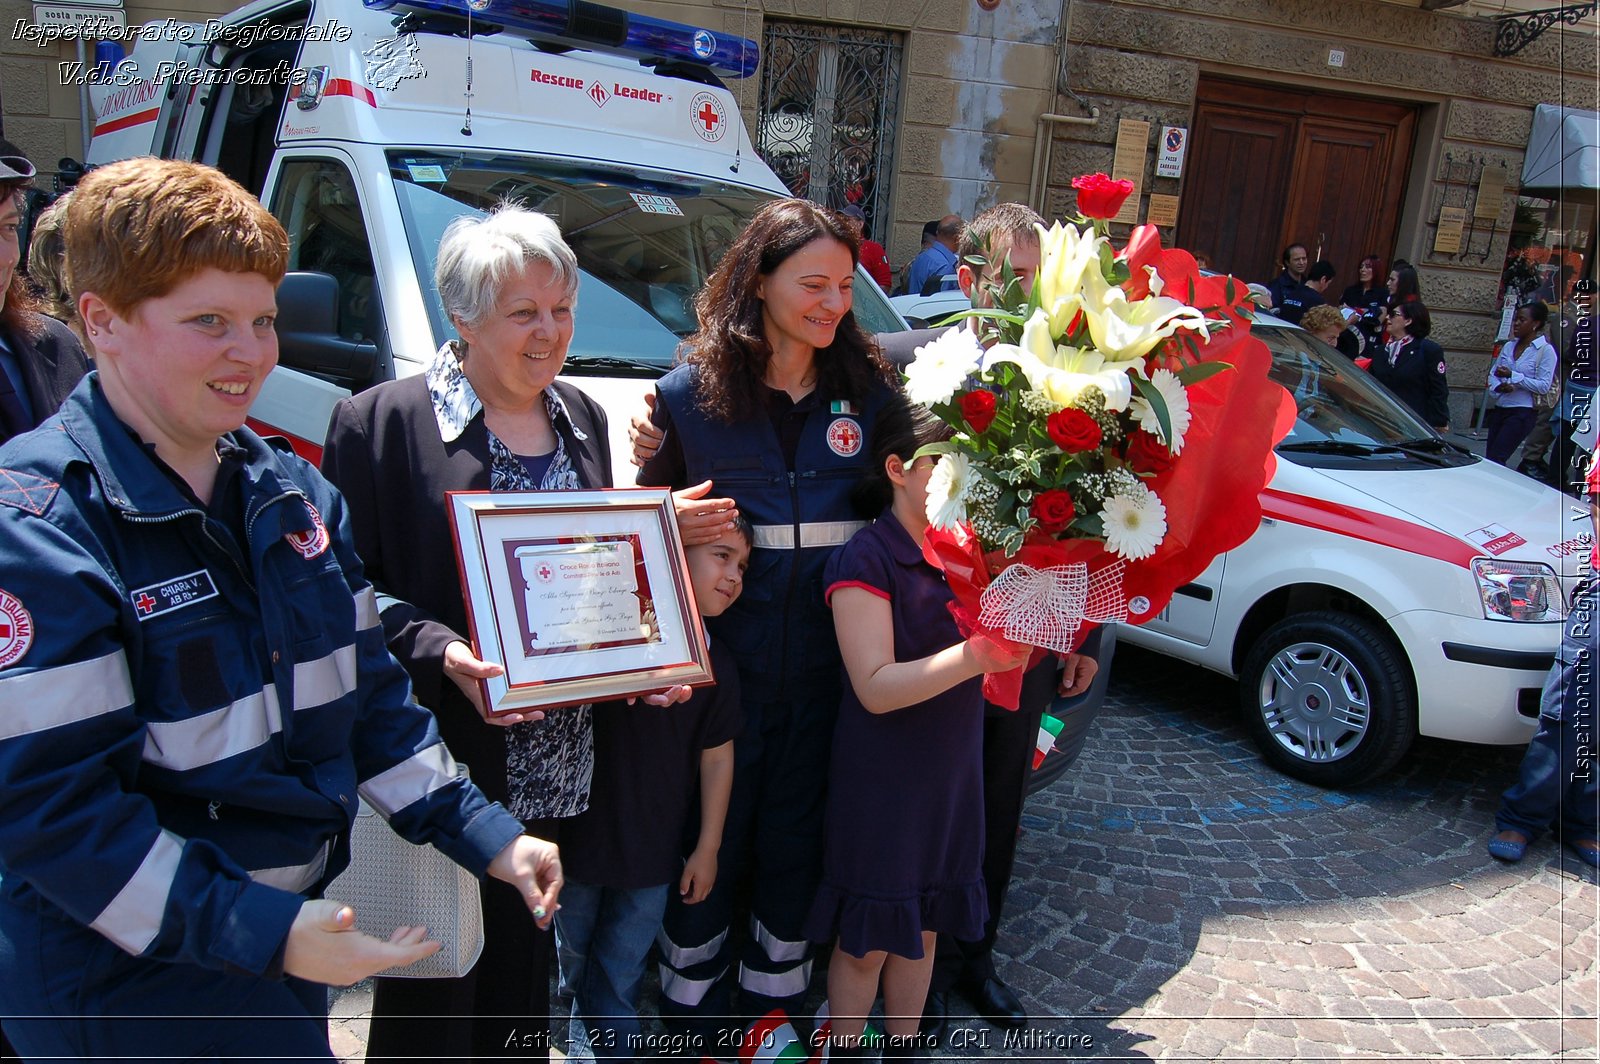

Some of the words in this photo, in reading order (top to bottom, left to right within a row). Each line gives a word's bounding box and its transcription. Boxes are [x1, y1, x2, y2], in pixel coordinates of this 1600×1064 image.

[45, 11, 71, 20] sosta
[75, 13, 115, 22] massima
[1330, 53, 1342, 63] 29
[530, 69, 584, 90] Rescue
[613, 83, 664, 104] Leader
[160, 581, 192, 598] CHIARA
[190, 578, 202, 587] V.
[170, 594, 182, 606] AB
[4, 597, 30, 637] ITALIANA
